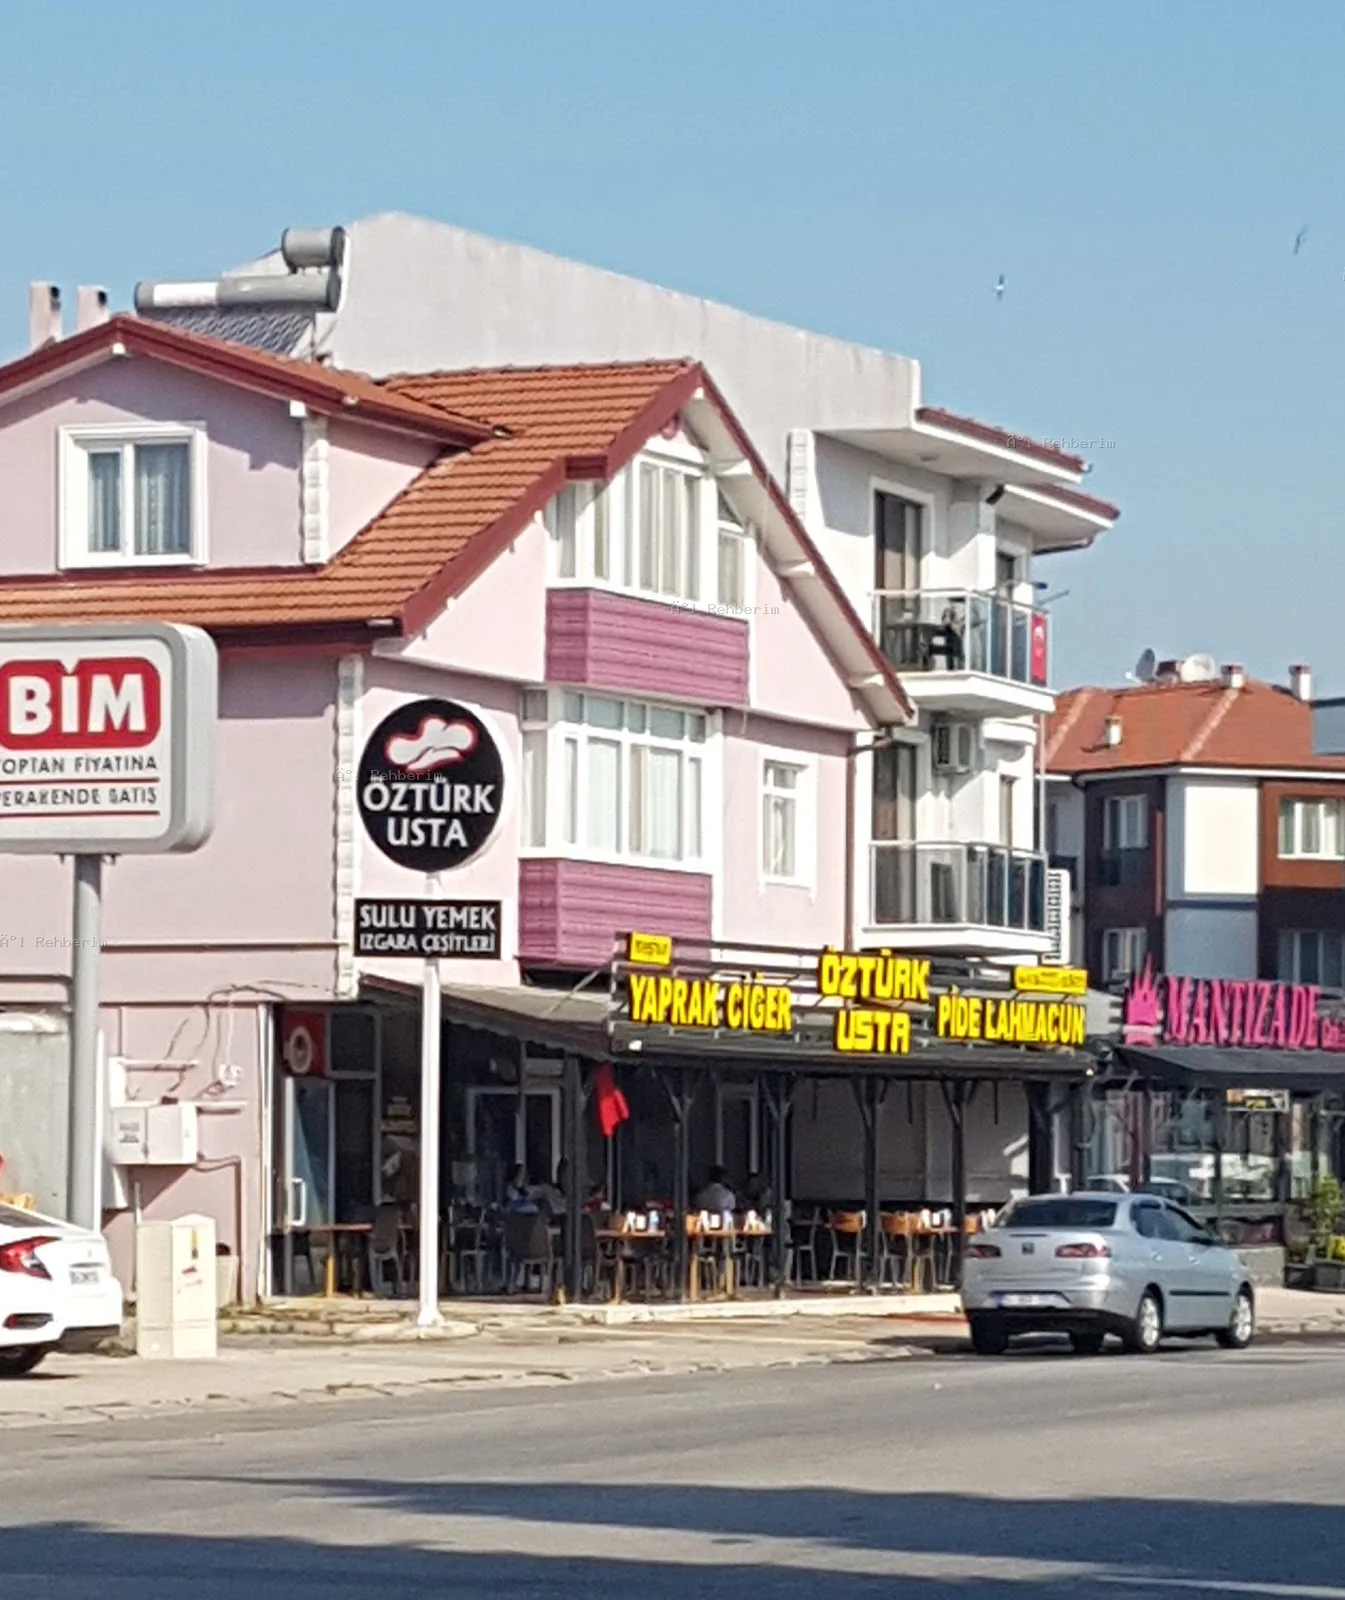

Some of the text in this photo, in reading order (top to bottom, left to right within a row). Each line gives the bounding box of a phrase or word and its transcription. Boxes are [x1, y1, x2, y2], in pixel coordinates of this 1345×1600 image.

[0, 788, 101, 807] ERAKENDE
[363, 776, 495, 813] ÖZTÜRK
[386, 817, 469, 848] USTA
[359, 905, 497, 930] SULU YEMEK
[820, 944, 932, 1001] ÖZTÜRK
[629, 973, 719, 1027] YAPRAK
[937, 984, 1086, 1045] PİDE LAHMACUN
[836, 1009, 911, 1055] USTA
